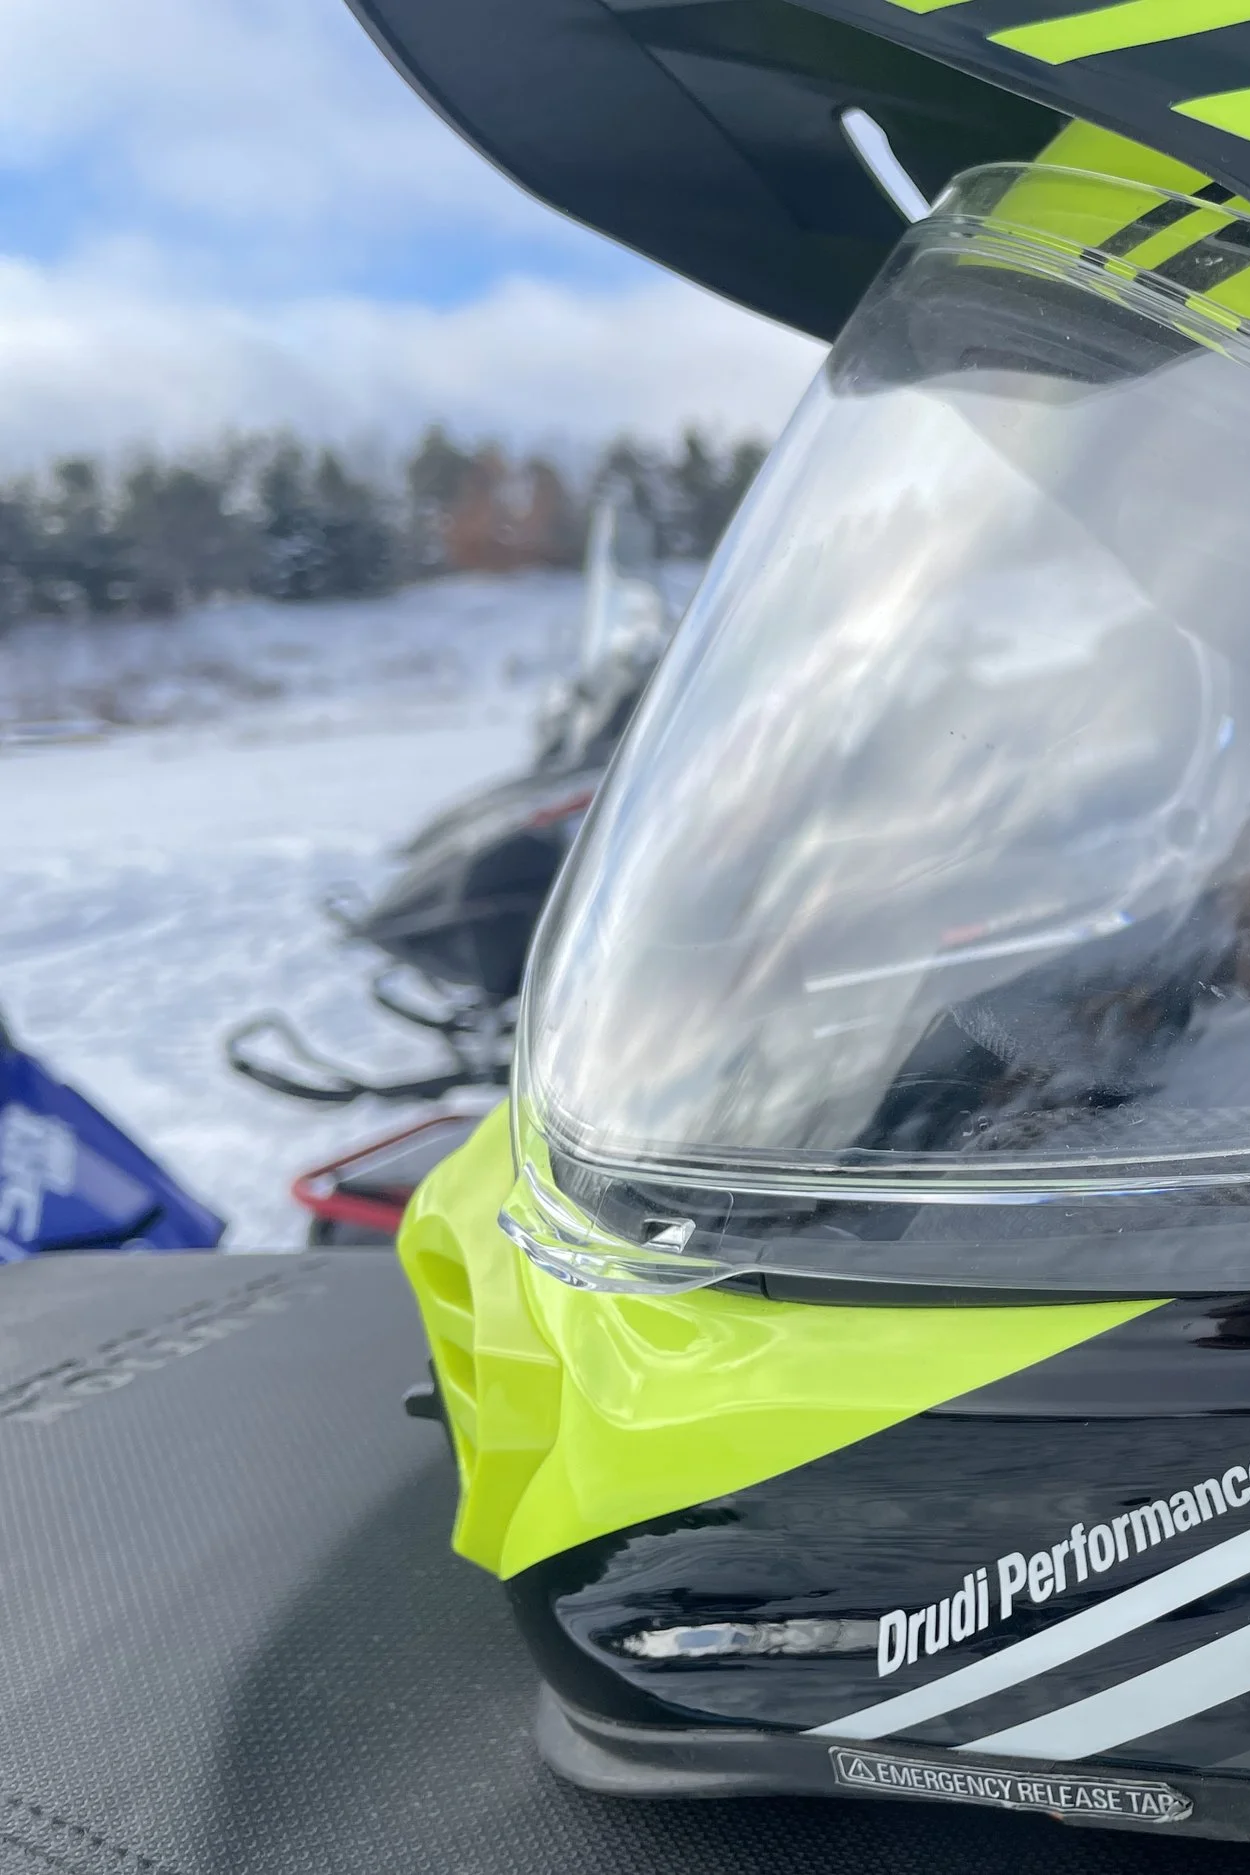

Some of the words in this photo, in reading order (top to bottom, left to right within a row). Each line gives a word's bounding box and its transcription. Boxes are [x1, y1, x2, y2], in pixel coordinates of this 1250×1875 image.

[877, 1566, 990, 1678] Drudi
[875, 1762, 1013, 1801] EMERGENCY
[1016, 1780, 1123, 1813] RELEASE
